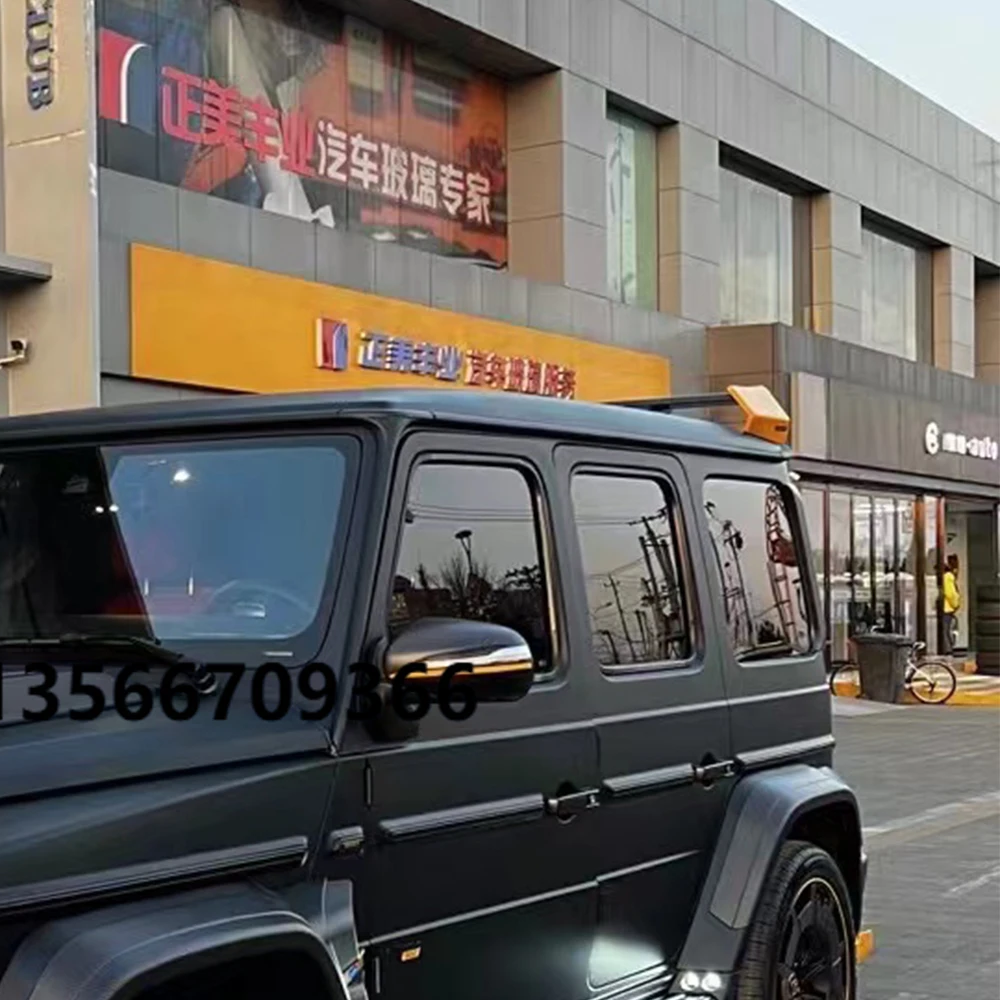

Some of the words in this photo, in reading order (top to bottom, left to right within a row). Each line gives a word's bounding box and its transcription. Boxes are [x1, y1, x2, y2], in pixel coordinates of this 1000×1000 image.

[316, 119, 492, 226] 汽车玻璃专家
